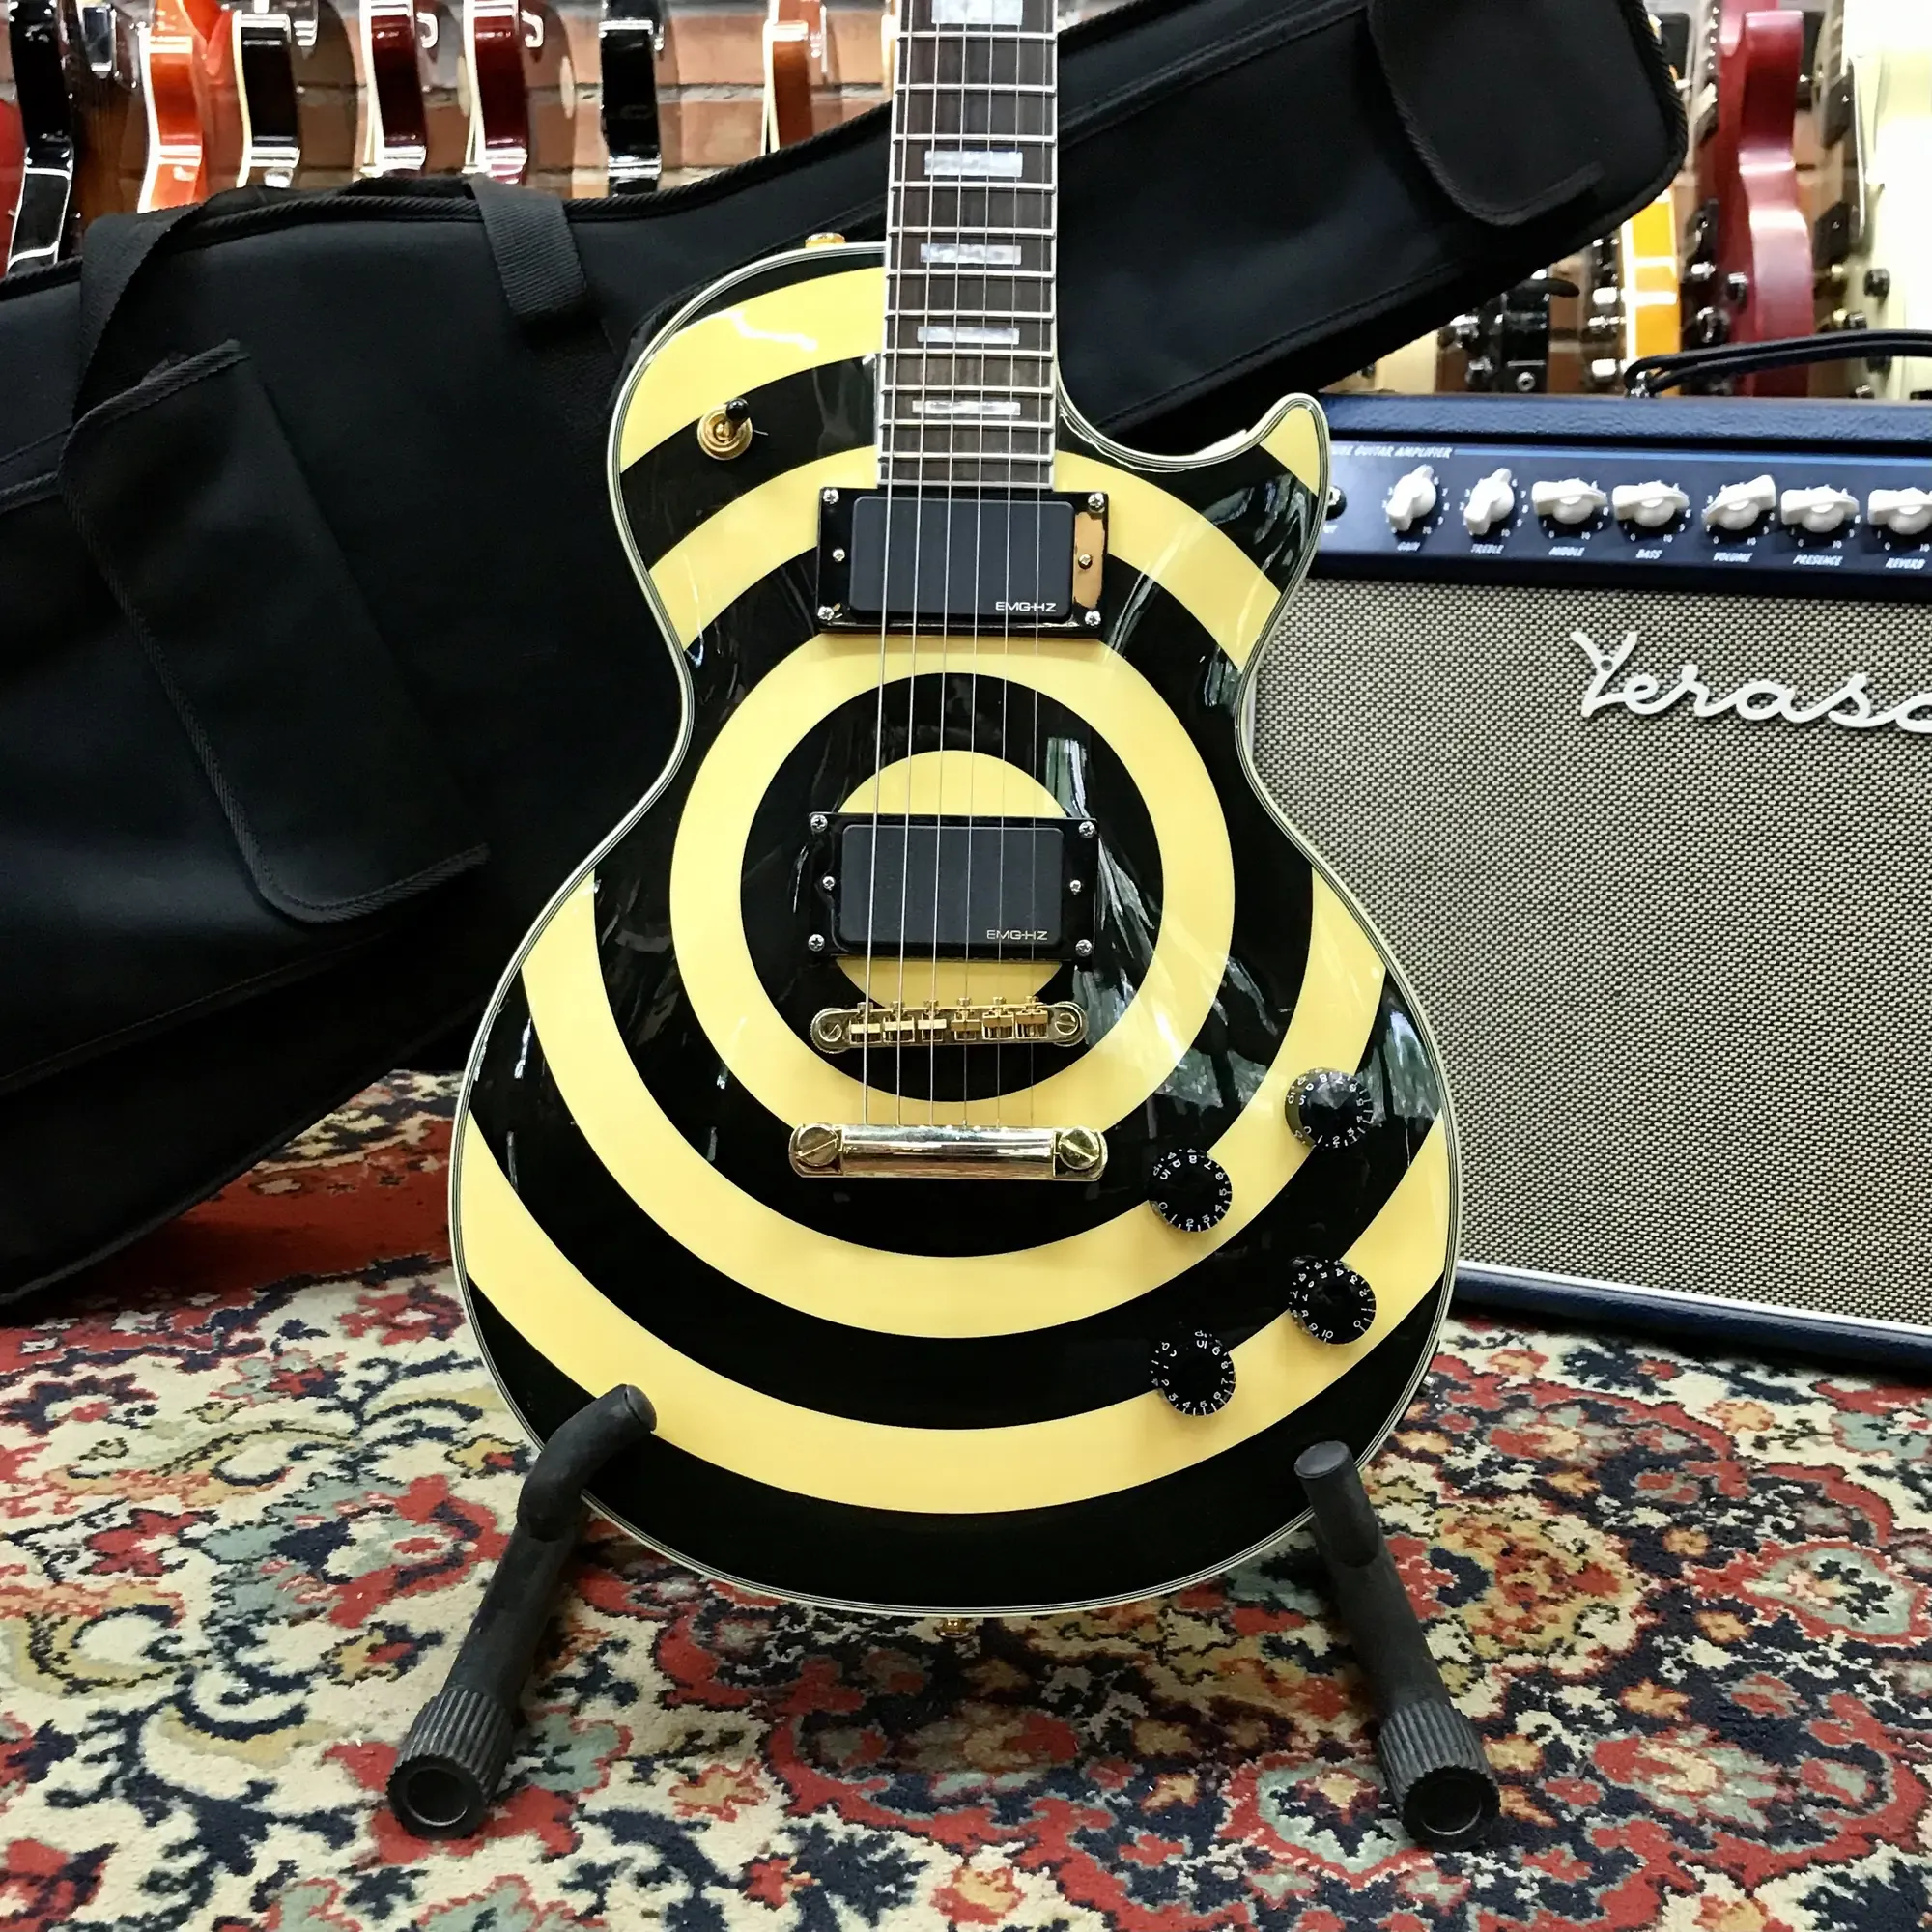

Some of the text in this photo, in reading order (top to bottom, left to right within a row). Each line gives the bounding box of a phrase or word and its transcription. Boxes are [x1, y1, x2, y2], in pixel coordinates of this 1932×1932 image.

[1354, 445, 1394, 457] GUITAR
[1394, 446, 1453, 459] AMPLIFIER
[1470, 543, 1505, 554] TREBLE
[1548, 546, 1585, 557] MIDDLE
[1635, 548, 1662, 559] BASS
[1713, 552, 1753, 562] VOLUME
[1792, 554, 1844, 566] PRESENCE
[1885, 557, 1927, 570] REVERB
[1321, 1329, 1333, 1339] 10
